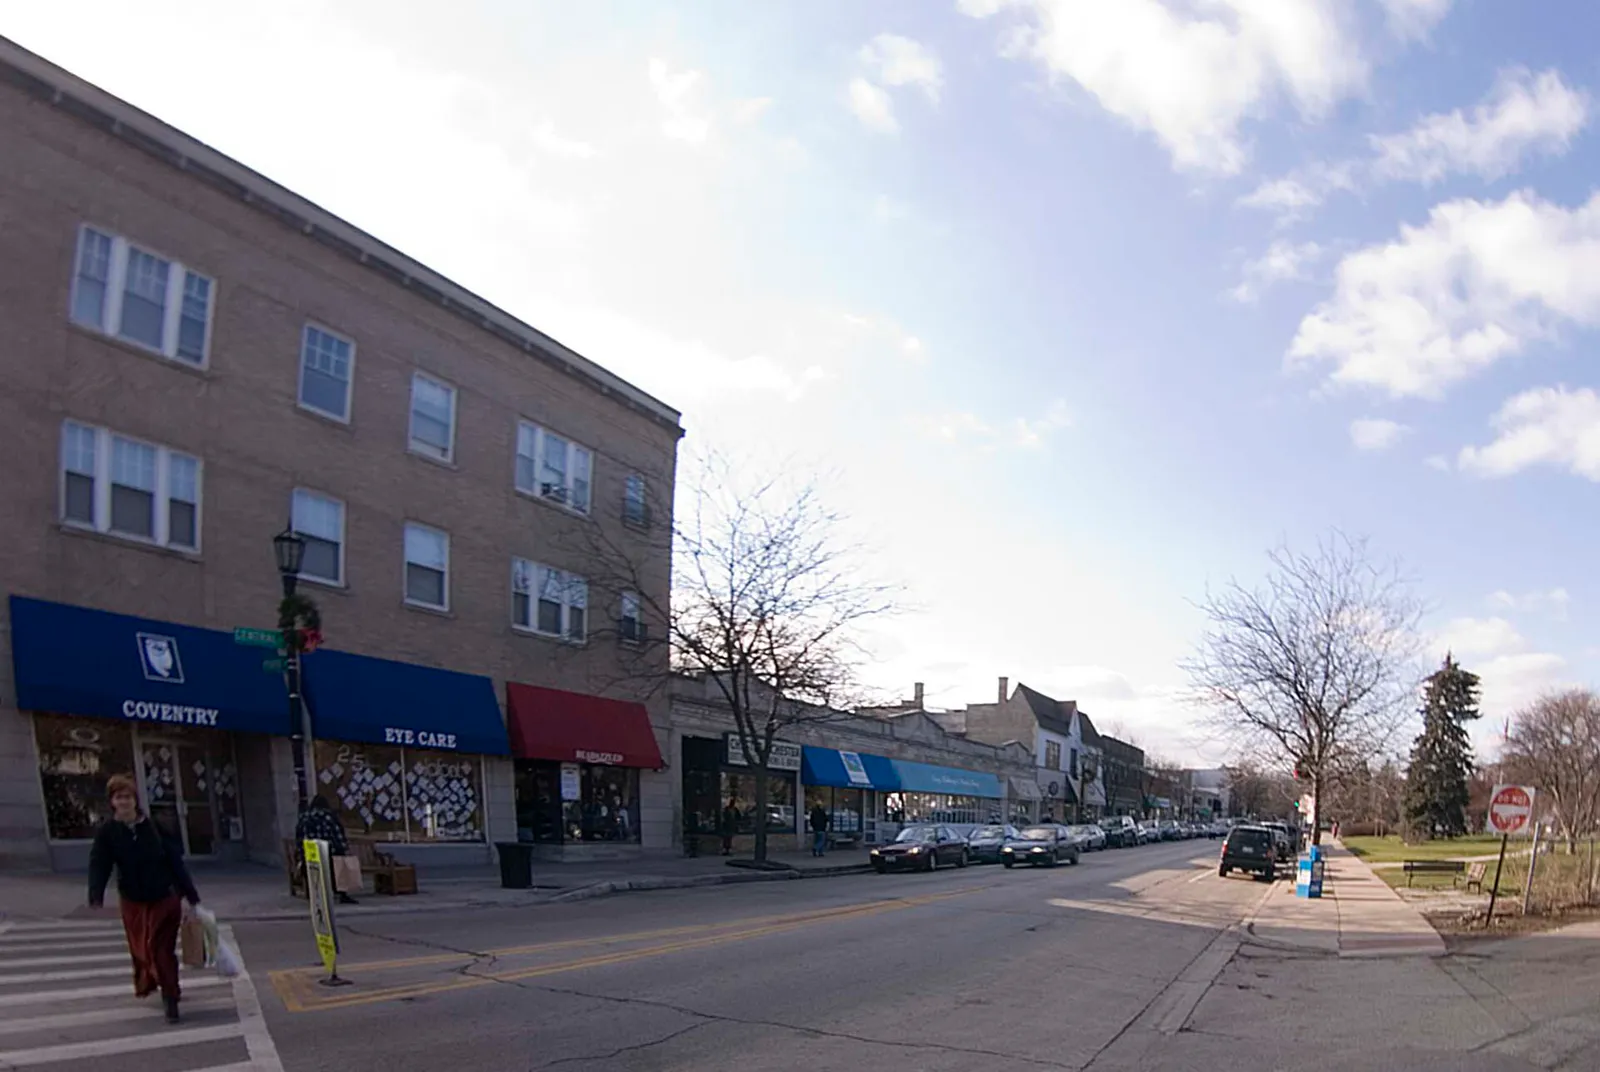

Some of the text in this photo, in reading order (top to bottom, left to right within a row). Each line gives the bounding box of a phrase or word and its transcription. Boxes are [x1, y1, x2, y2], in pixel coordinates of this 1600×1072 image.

[122, 699, 219, 725] COVENTRY
[385, 727, 457, 749] EYE CARE
